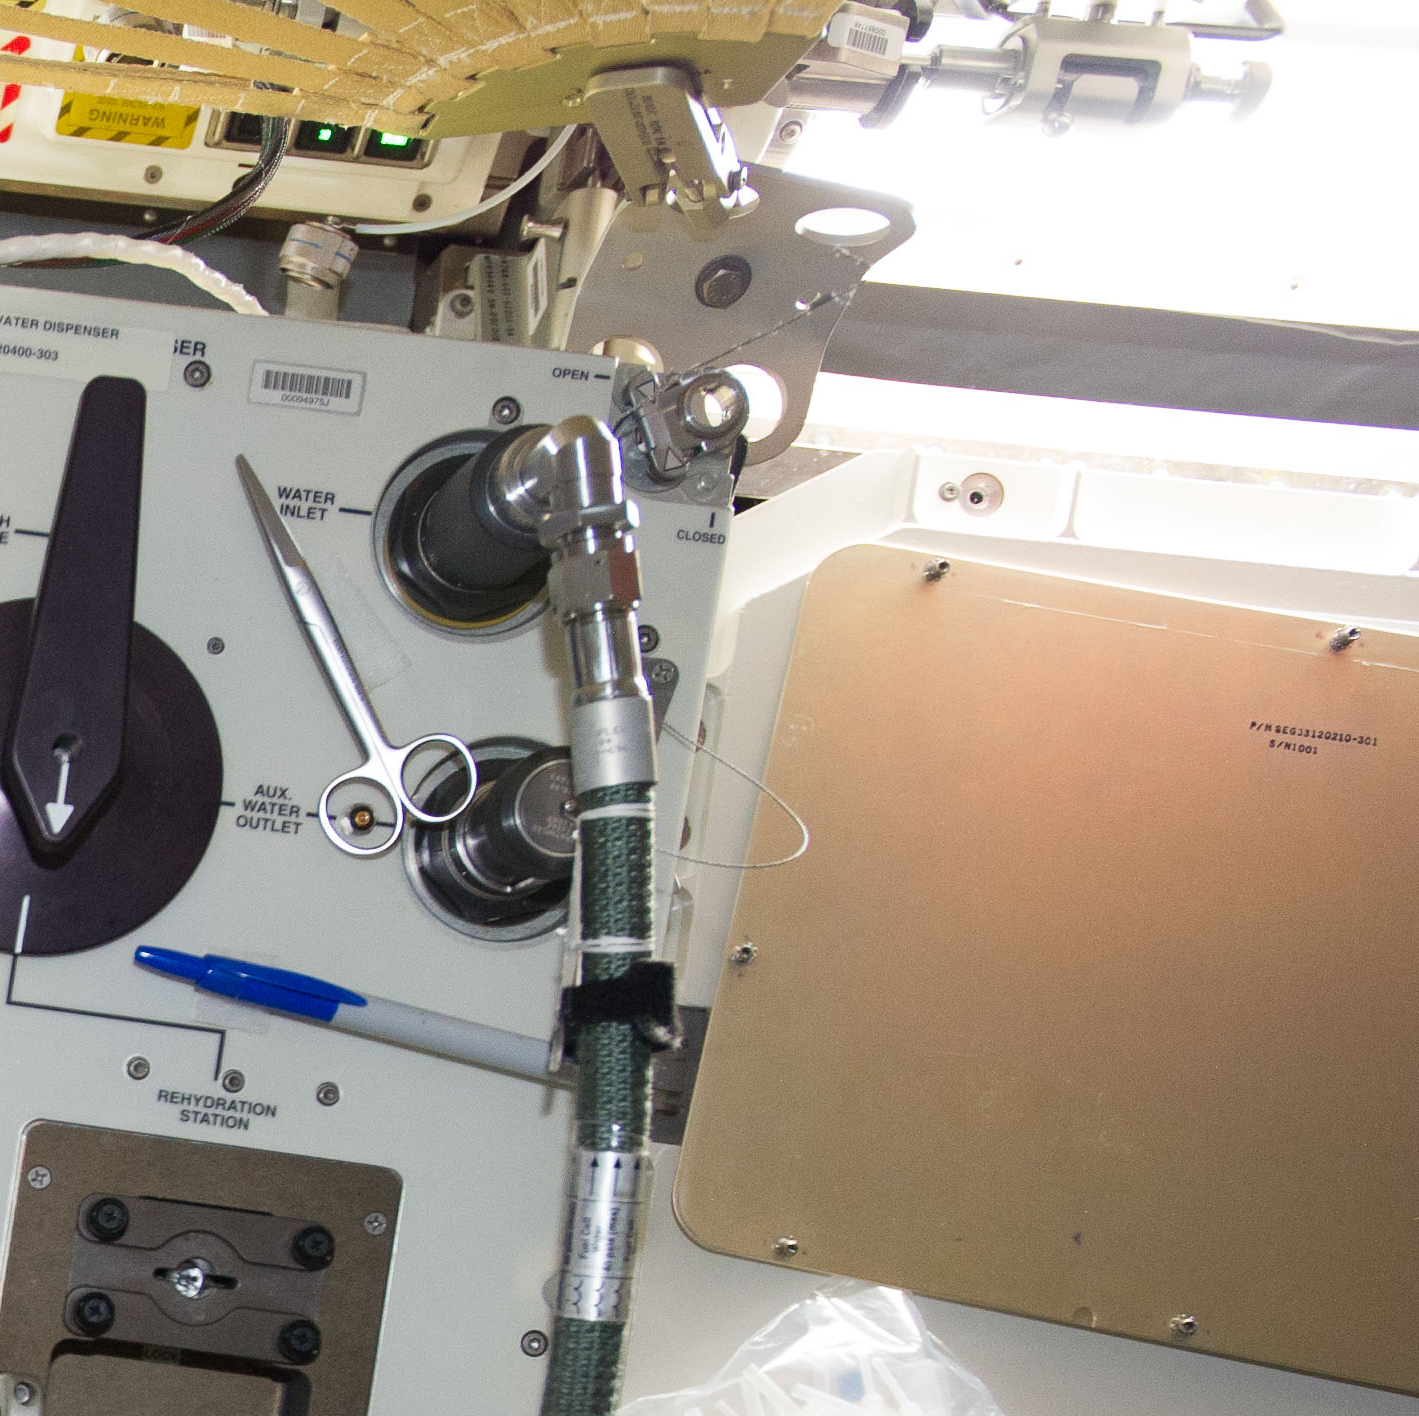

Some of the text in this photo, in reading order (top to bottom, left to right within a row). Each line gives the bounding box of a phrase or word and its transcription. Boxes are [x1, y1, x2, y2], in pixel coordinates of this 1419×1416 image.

[88, 108, 166, 129] WARNING
[43, 320, 120, 340] DISPENSER
[551, 366, 591, 383] OPEN
[276, 485, 337, 506] WATER
[279, 502, 328, 521] INLET
[676, 528, 727, 546] CLOSED
[253, 784, 294, 803] AUX.
[242, 798, 302, 820] WATER
[235, 813, 306, 836] OUTLET
[156, 1087, 279, 1119] REHYDRATION
[178, 1107, 252, 1133] STATION
